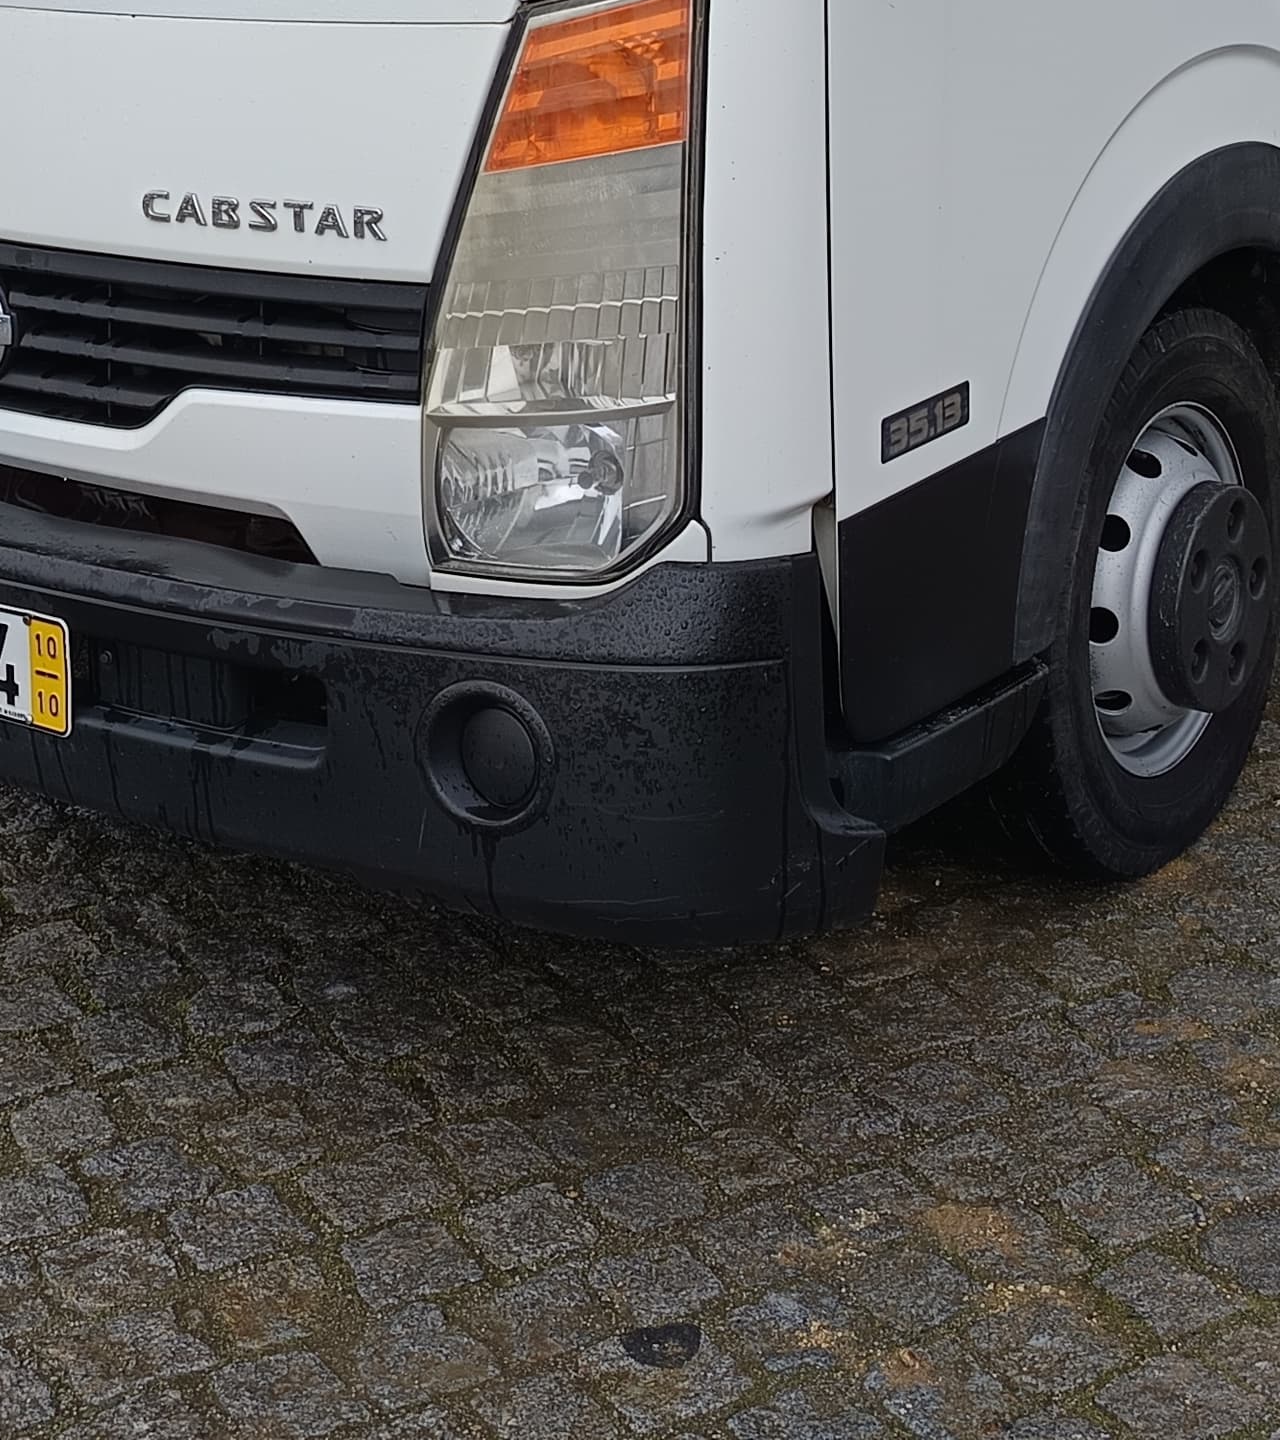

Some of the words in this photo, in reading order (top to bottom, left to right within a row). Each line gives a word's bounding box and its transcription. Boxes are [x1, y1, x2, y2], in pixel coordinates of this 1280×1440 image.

[142, 189, 387, 242] CABSTAR
[35, 633, 58, 659] 10
[37, 690, 59, 717] 10
